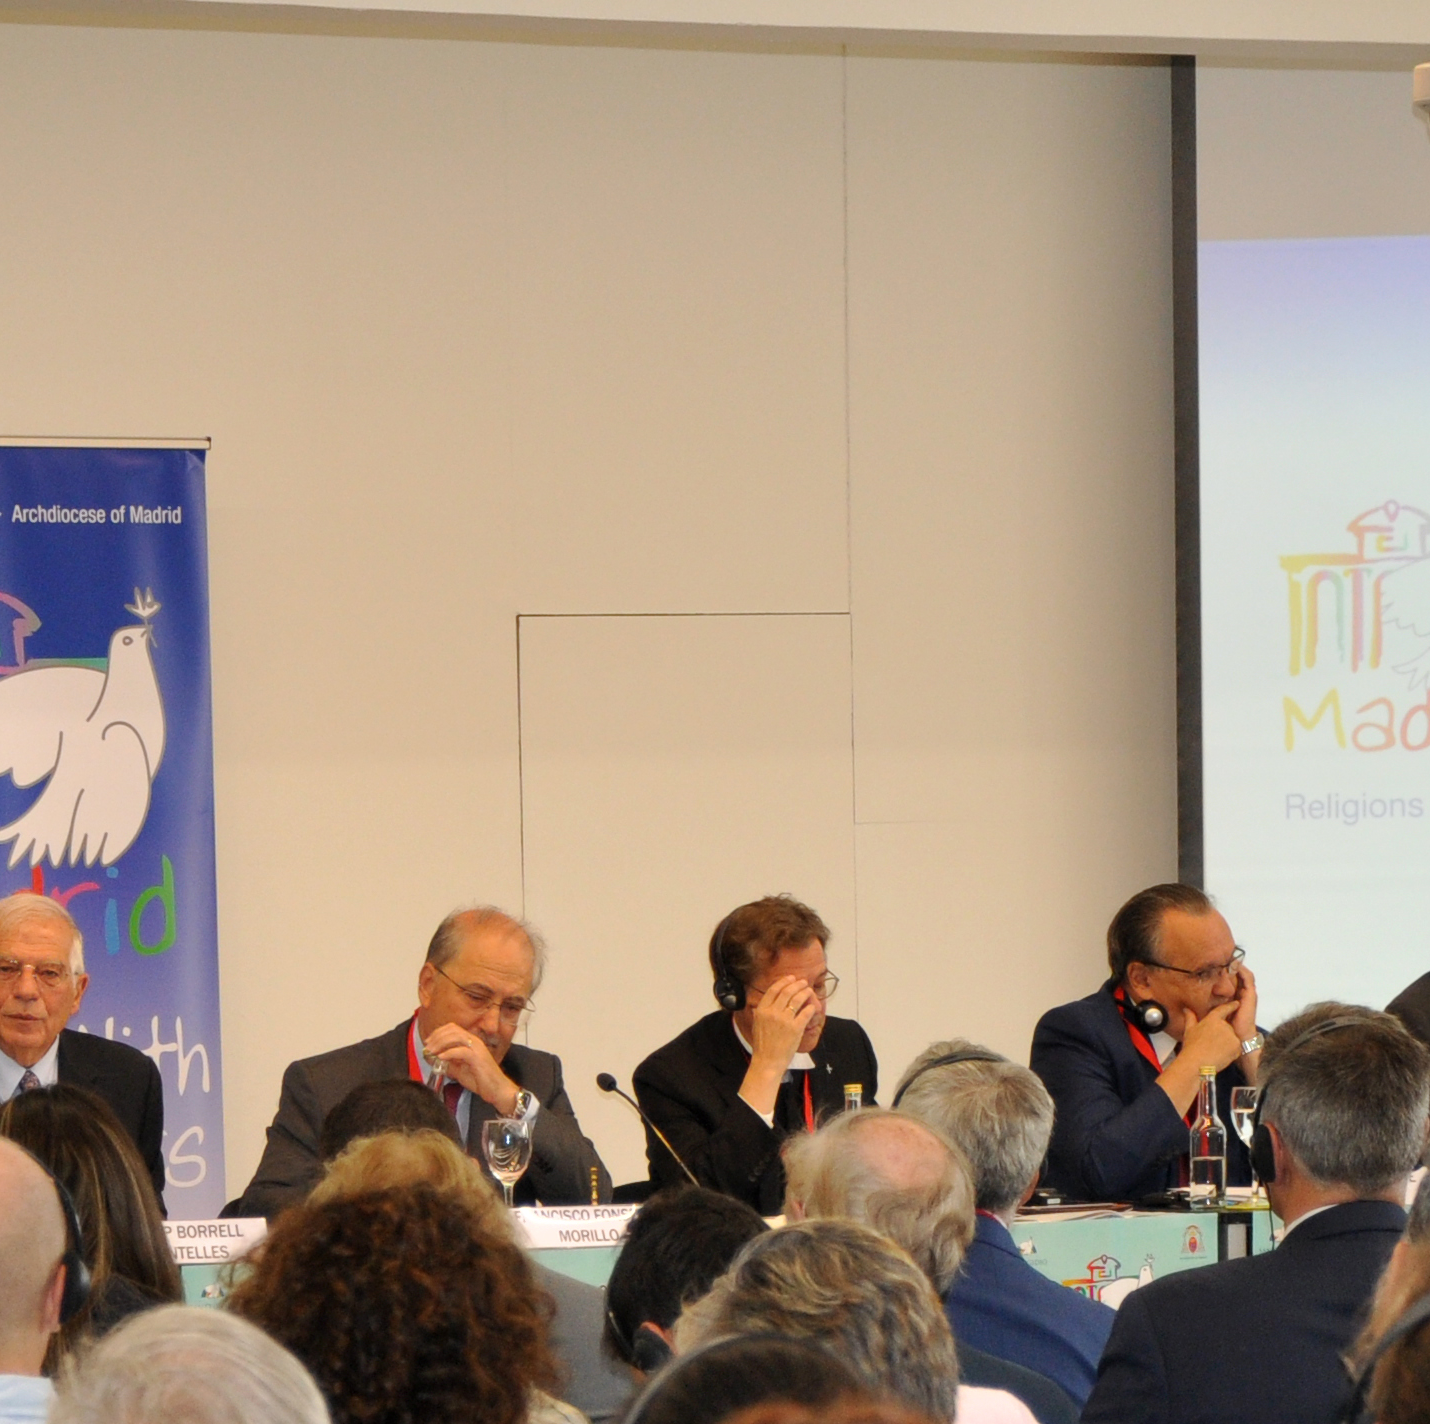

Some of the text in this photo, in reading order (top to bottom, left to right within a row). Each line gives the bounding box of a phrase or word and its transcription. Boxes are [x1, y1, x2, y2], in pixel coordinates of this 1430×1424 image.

[11, 504, 106, 524] Archdiocese
[110, 505, 125, 524] of
[129, 505, 182, 524] Madrid
[1284, 793, 1424, 826] Religions
[176, 1223, 245, 1239] BORRELL
[558, 1229, 620, 1243] MORILLO
